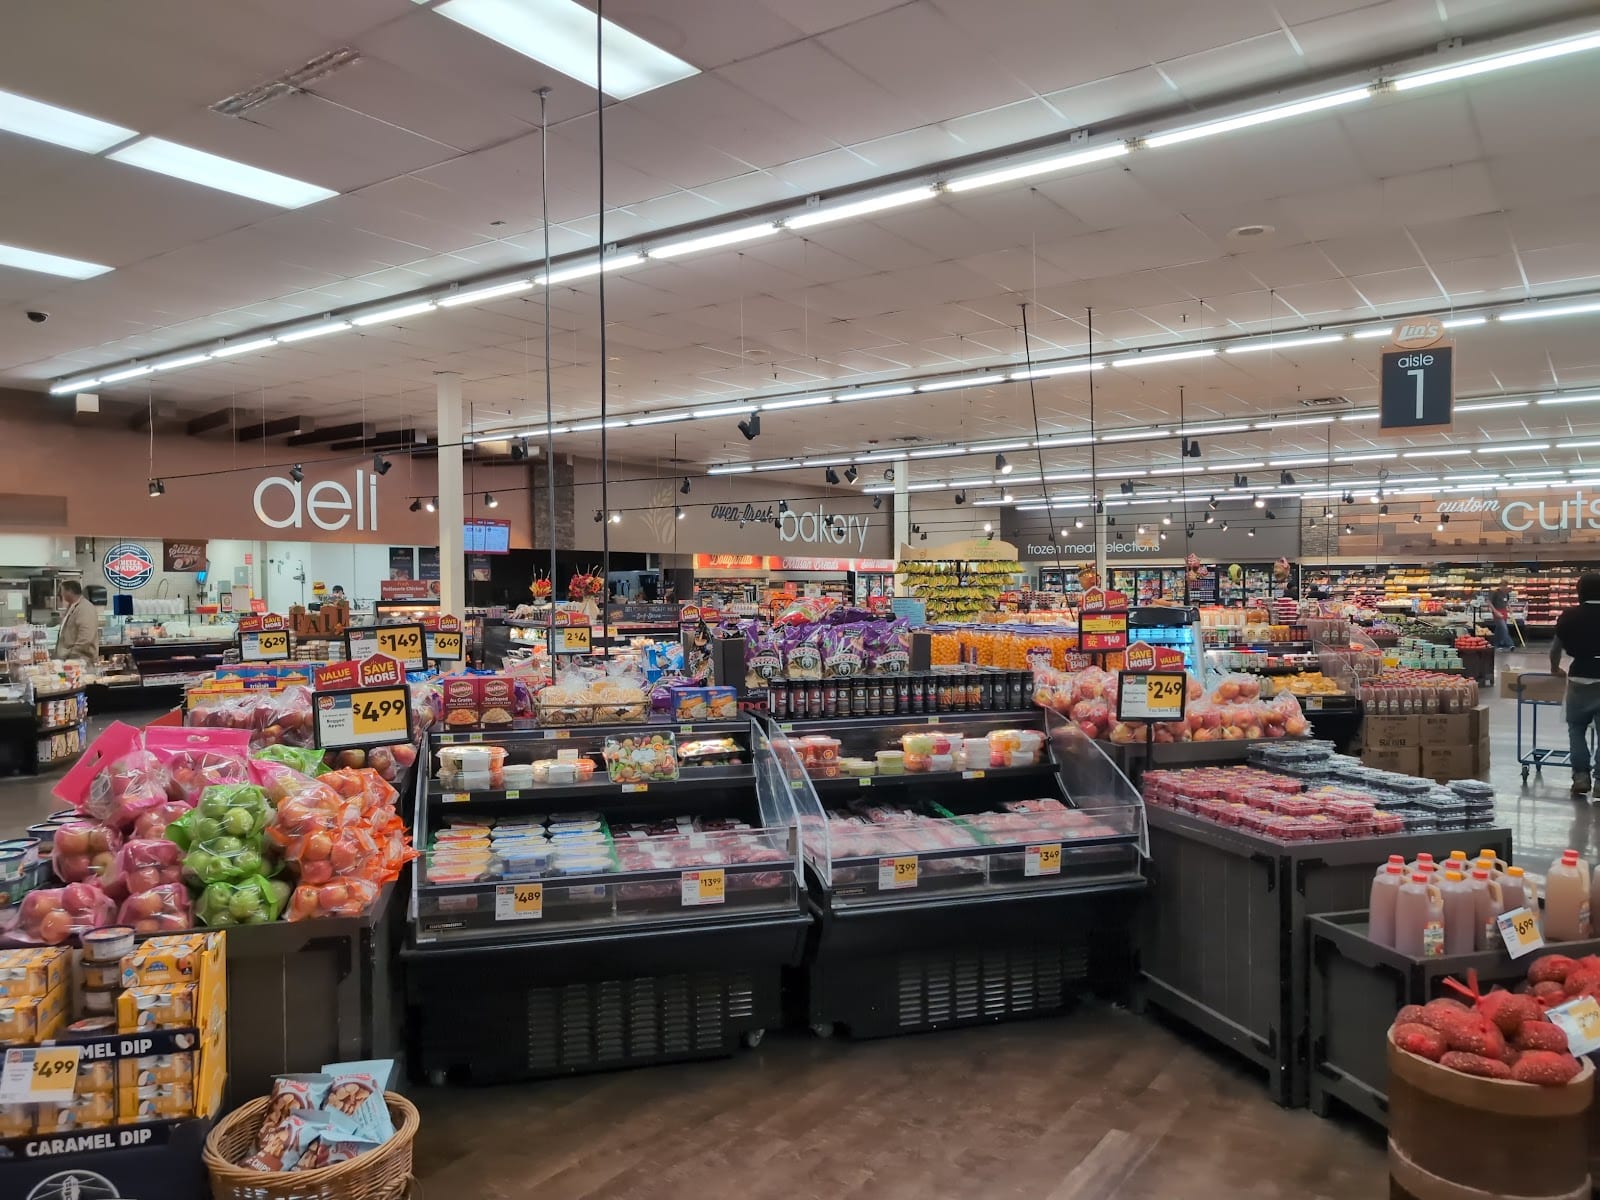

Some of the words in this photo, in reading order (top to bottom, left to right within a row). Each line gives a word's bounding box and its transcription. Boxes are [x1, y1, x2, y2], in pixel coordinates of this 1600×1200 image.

[1400, 322, 1439, 341] Lin's
[1398, 354, 1434, 368] aisle
[1407, 369, 1424, 419] 1
[1436, 497, 1500, 512] custom
[779, 504, 869, 553] bakery
[1027, 544, 1061, 555] frozen
[1106, 541, 1160, 553] elections
[259, 637, 285, 648] $629
[380, 633, 419, 652] $149
[434, 637, 459, 649] $649
[1129, 649, 1152, 660] SAVE
[1160, 656, 1181, 664] VALUE
[363, 661, 395, 675] SAVE
[1129, 658, 1153, 668] MORE
[319, 667, 351, 681] VALUE
[364, 671, 397, 684] MORE
[1147, 681, 1182, 699] $249
[353, 699, 404, 722] $499
[895, 863, 915, 874] $399
[514, 891, 541, 903] $489
[1514, 918, 1534, 935] $699
[120, 1038, 153, 1054] DIP
[32, 1060, 74, 1078] $499
[26, 1132, 116, 1157] CARAMEL
[120, 1128, 152, 1146] DIP
